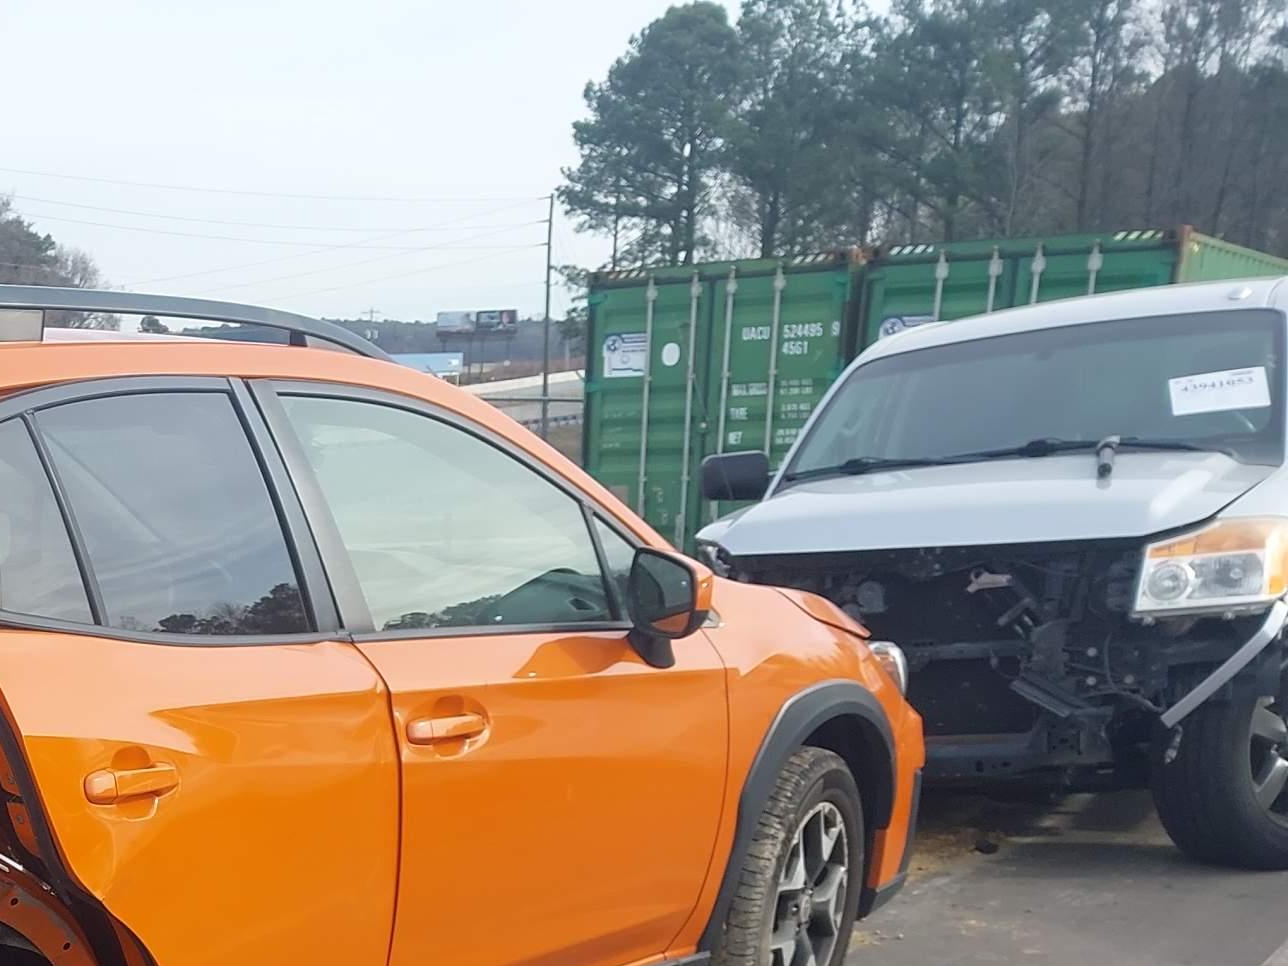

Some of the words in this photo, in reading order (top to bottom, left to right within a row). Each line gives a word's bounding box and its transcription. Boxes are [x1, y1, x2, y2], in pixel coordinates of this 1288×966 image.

[742, 326, 770, 340] UACU
[783, 323, 823, 338] 524495
[782, 341, 808, 354] 45G1
